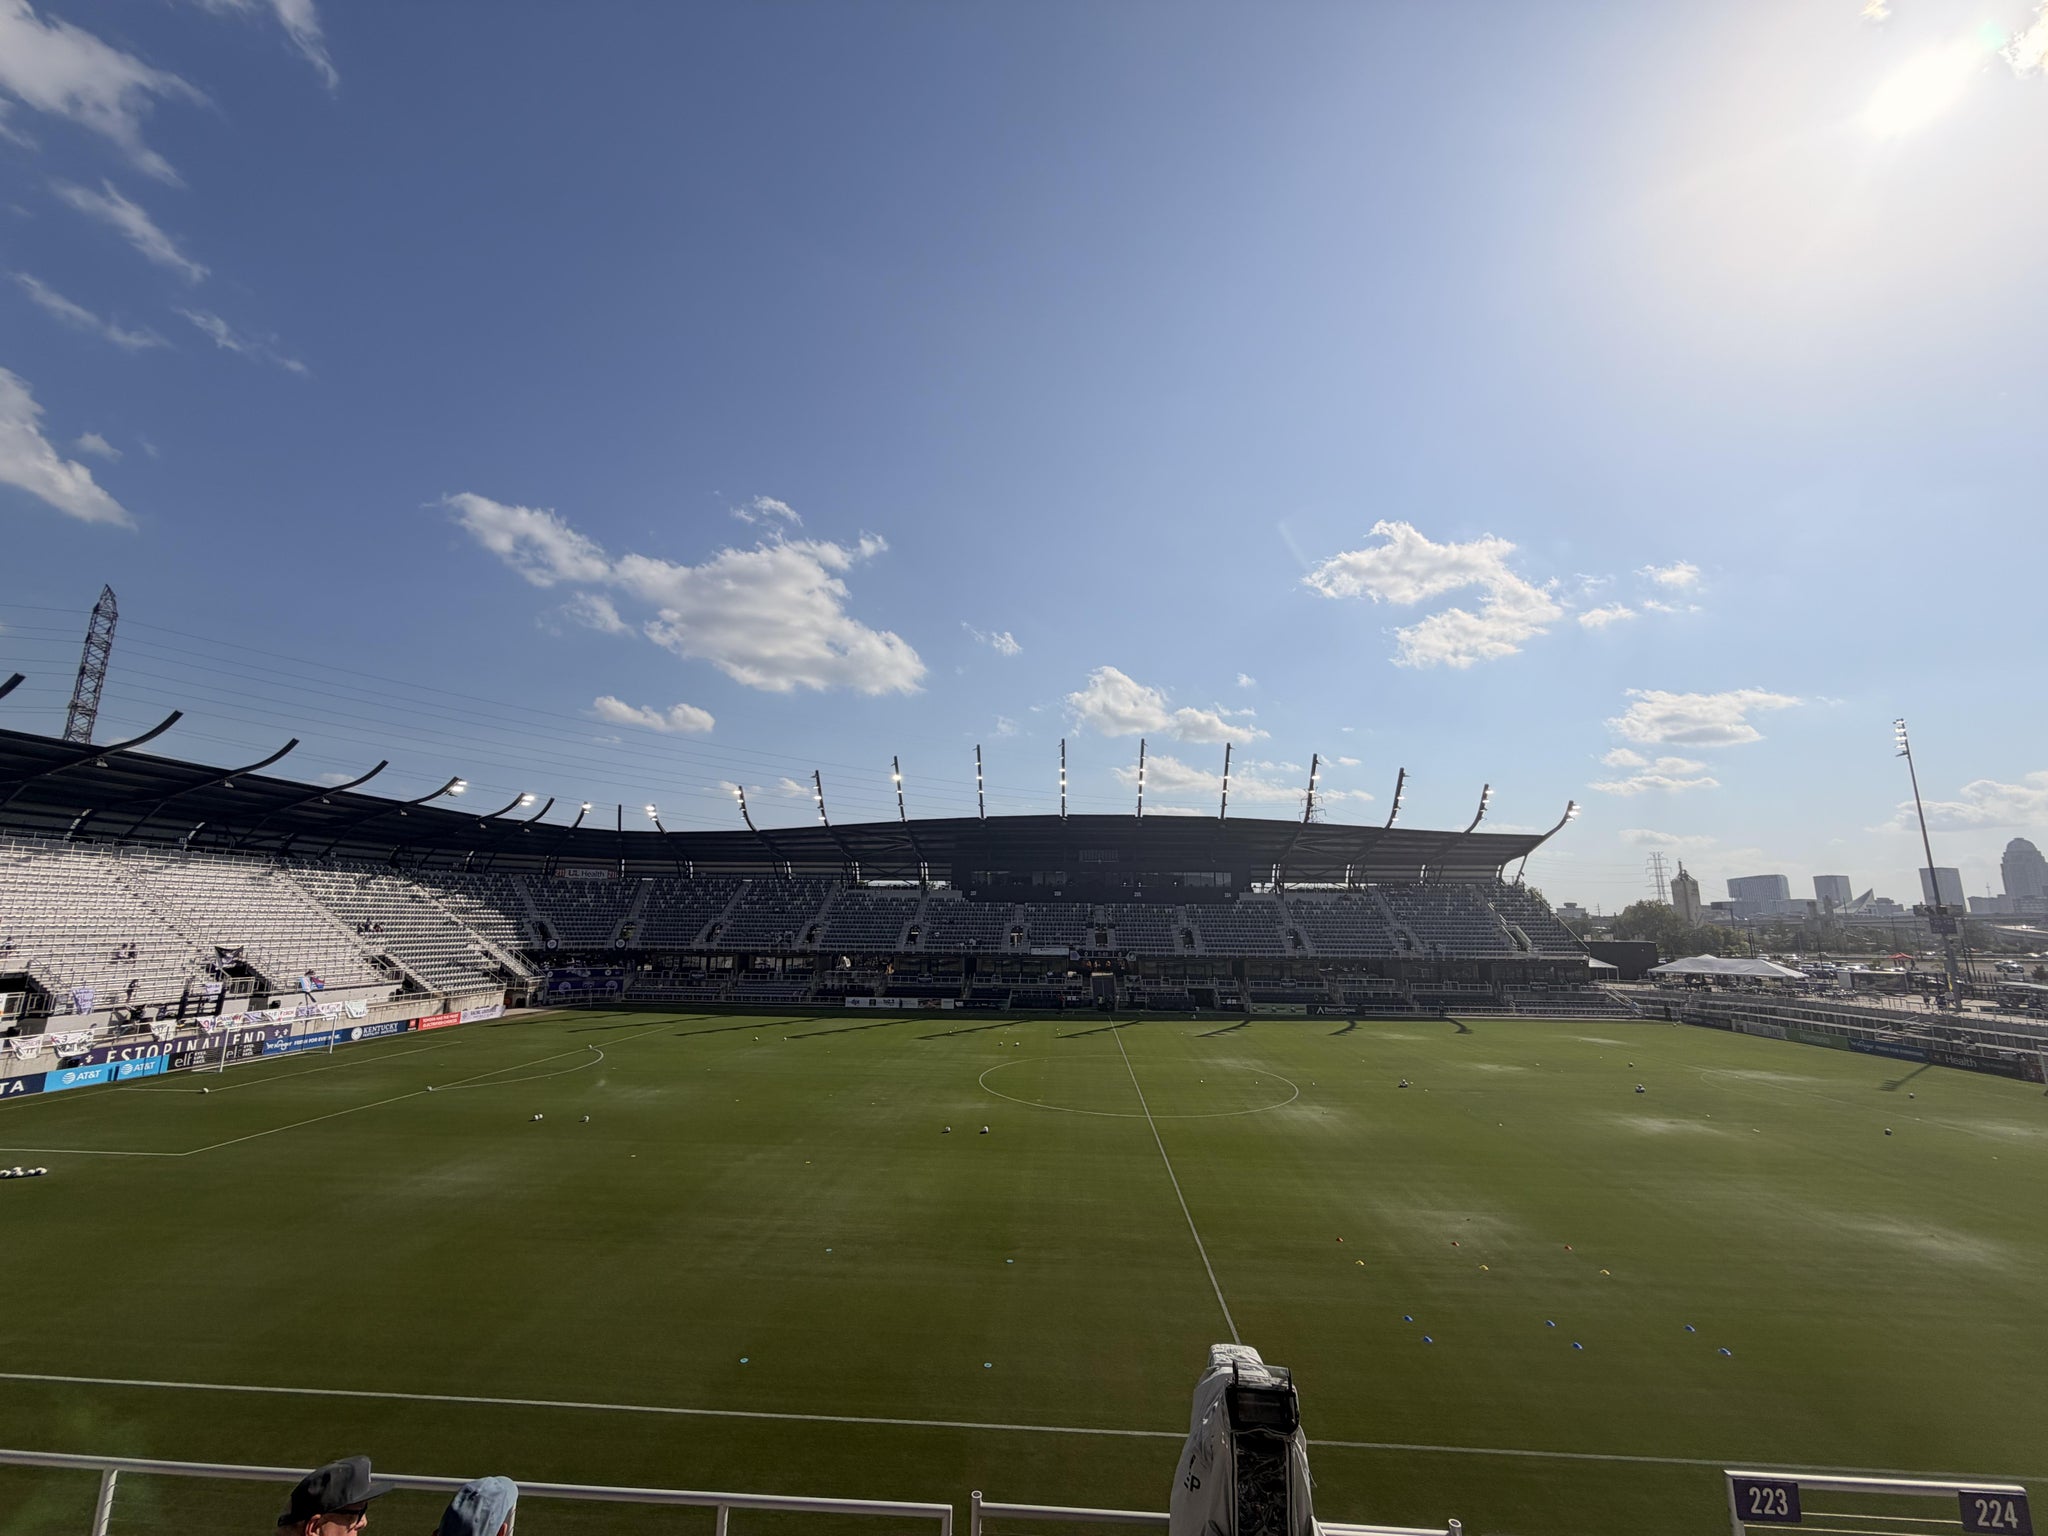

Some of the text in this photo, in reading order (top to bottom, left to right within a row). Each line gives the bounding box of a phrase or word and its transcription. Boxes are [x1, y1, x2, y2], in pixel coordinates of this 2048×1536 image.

[363, 1022, 399, 1034] KENTUCKY
[232, 1030, 266, 1045] END
[133, 1061, 156, 1072] AT&T
[174, 1051, 194, 1068] elf
[1945, 1055, 1977, 1068] Health
[76, 1069, 102, 1081] AT&T
[1748, 1486, 1789, 1516] 223
[1975, 1498, 2019, 1529] 224
